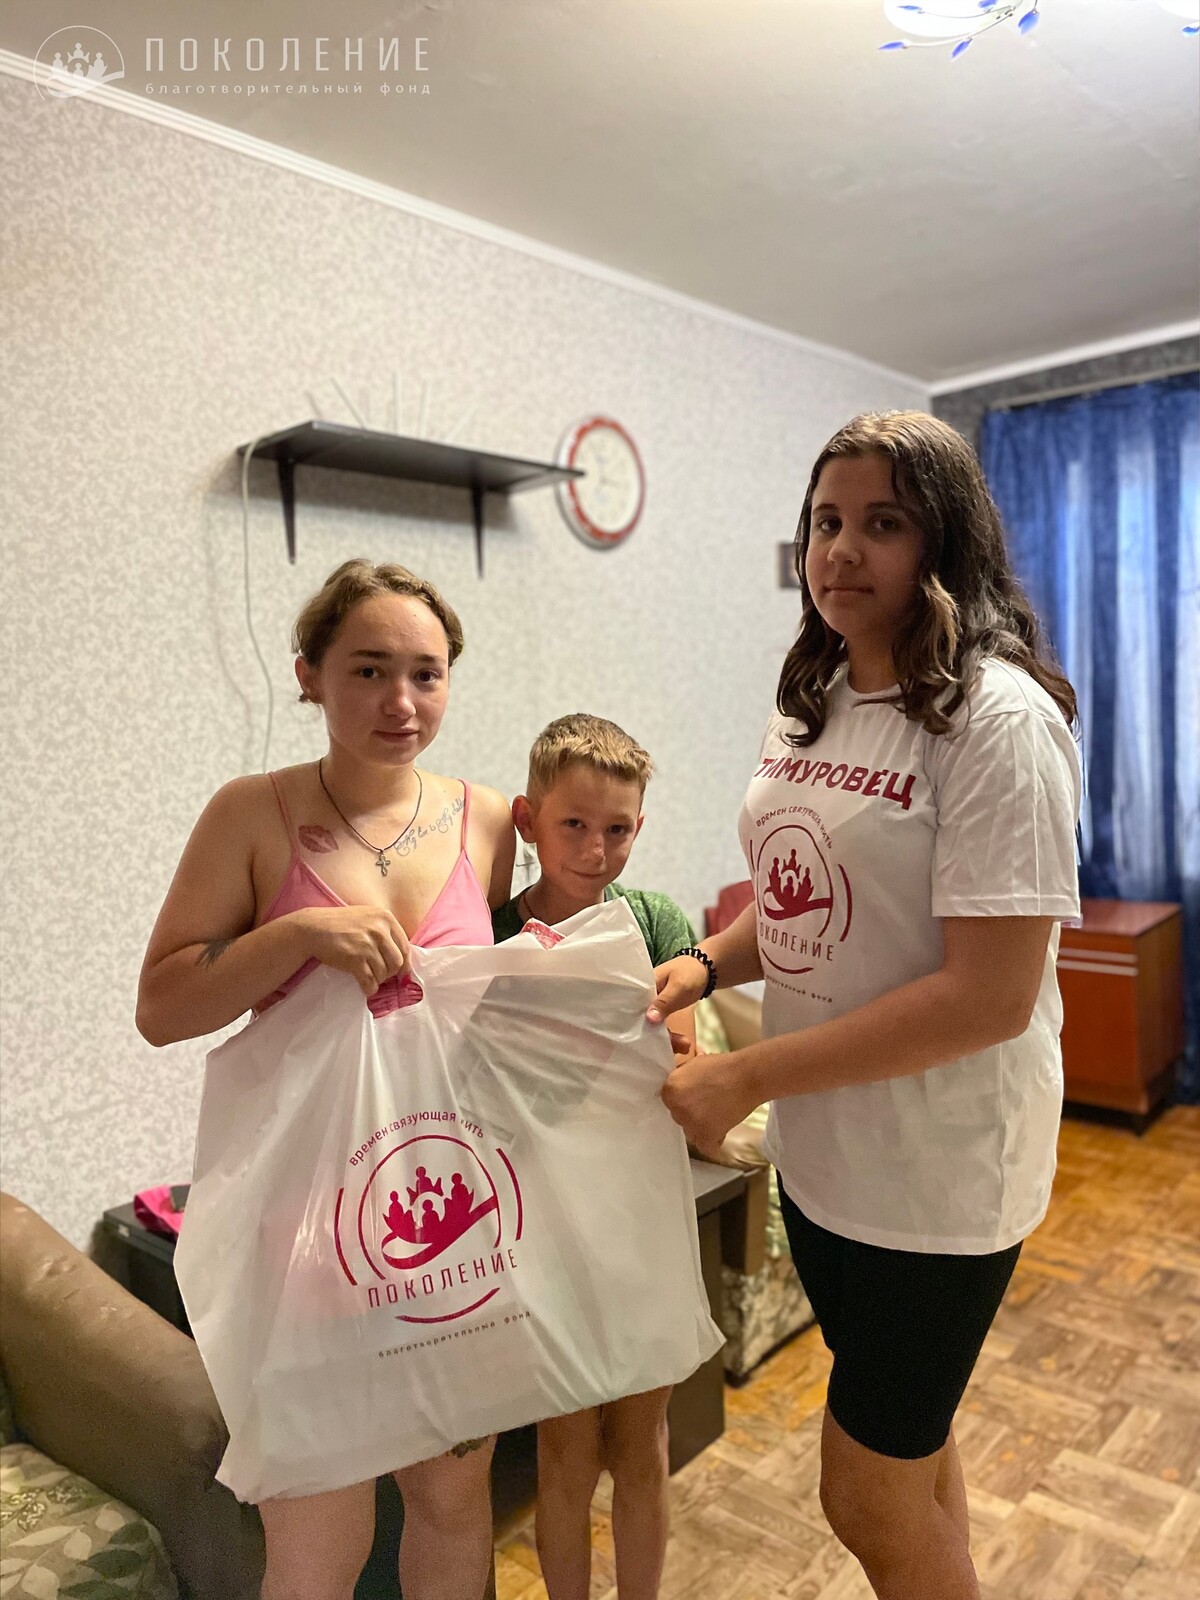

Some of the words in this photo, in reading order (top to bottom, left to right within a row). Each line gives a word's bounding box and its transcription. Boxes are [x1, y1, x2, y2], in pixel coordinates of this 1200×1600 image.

[753, 757, 917, 811] ТИМУРОВЕЦ
[755, 807, 787, 828] времен
[349, 1126, 389, 1167] времен
[367, 1248, 518, 1309] ПОКОЛЕНИЕ
